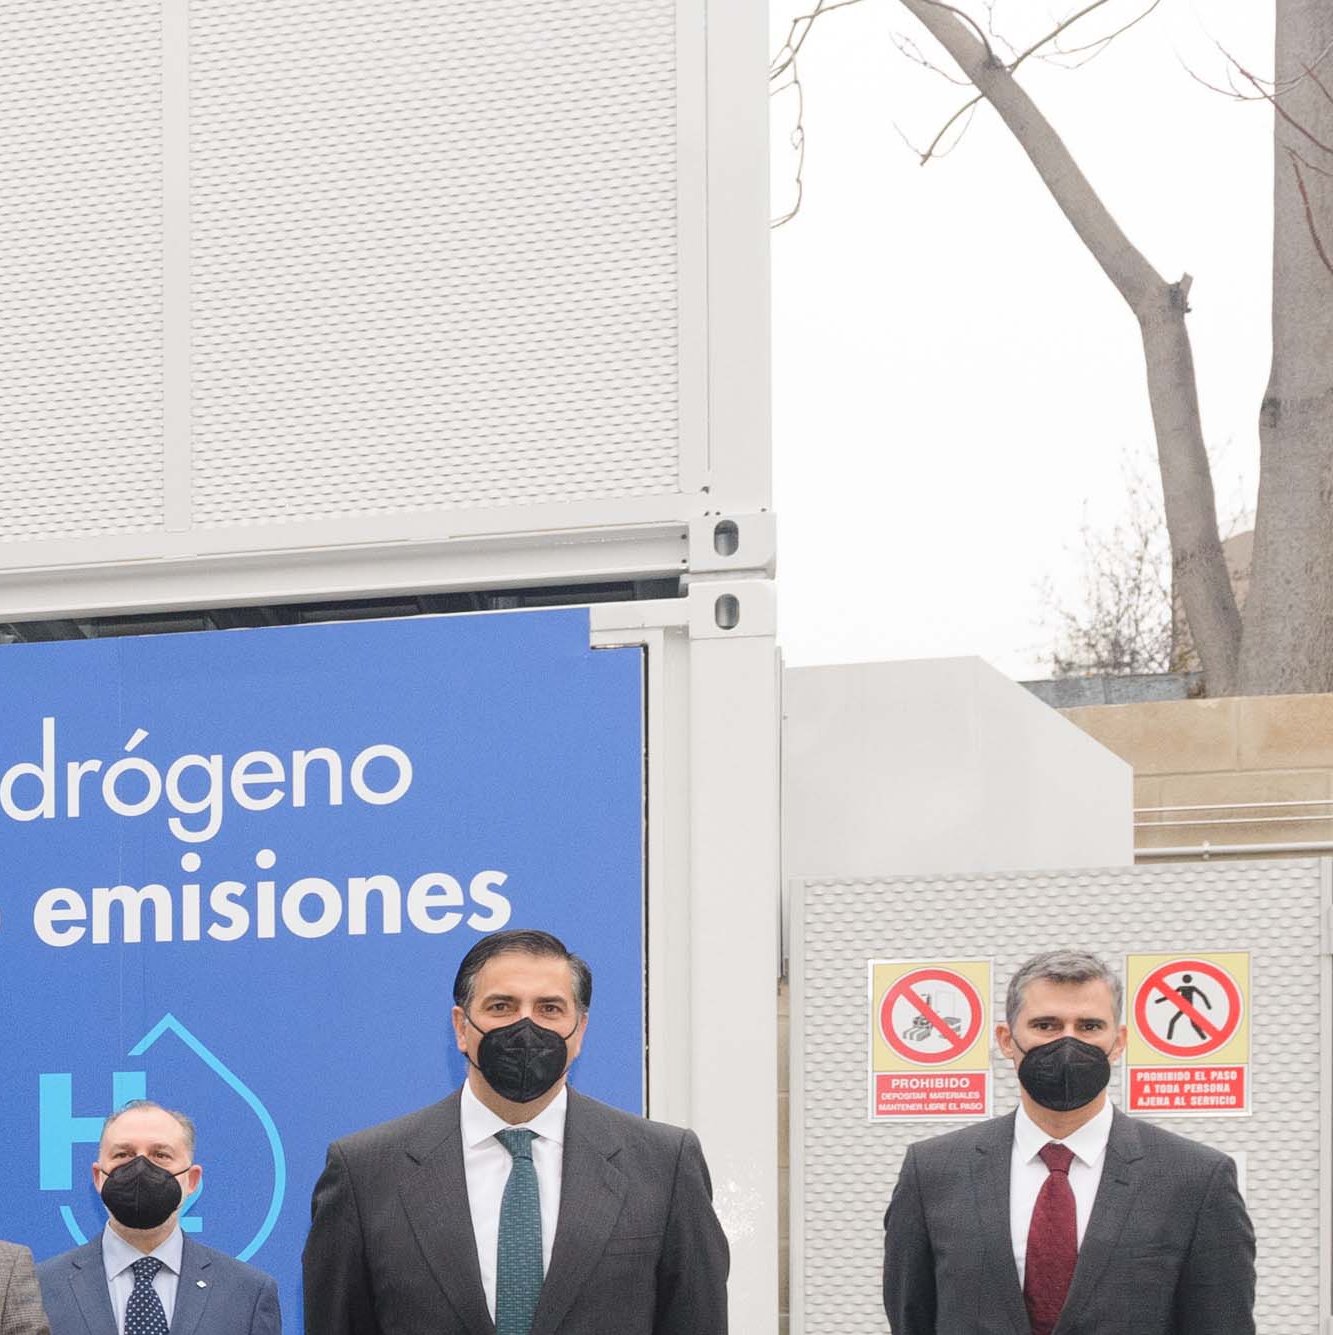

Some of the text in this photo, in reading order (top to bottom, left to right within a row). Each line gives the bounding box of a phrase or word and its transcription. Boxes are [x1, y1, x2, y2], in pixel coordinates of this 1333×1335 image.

[33, 848, 512, 948] emisiones
[1136, 1070, 1238, 1082] PROHIBIDO EL PASO
[891, 1077, 970, 1089] PROHIBIDO
[1142, 1082, 1231, 1094] A TODA PERSONA
[948, 1102, 959, 1111] EL
[960, 1102, 983, 1110] PASO
[1137, 1095, 1237, 1106] AJENA AL SERVICIO
